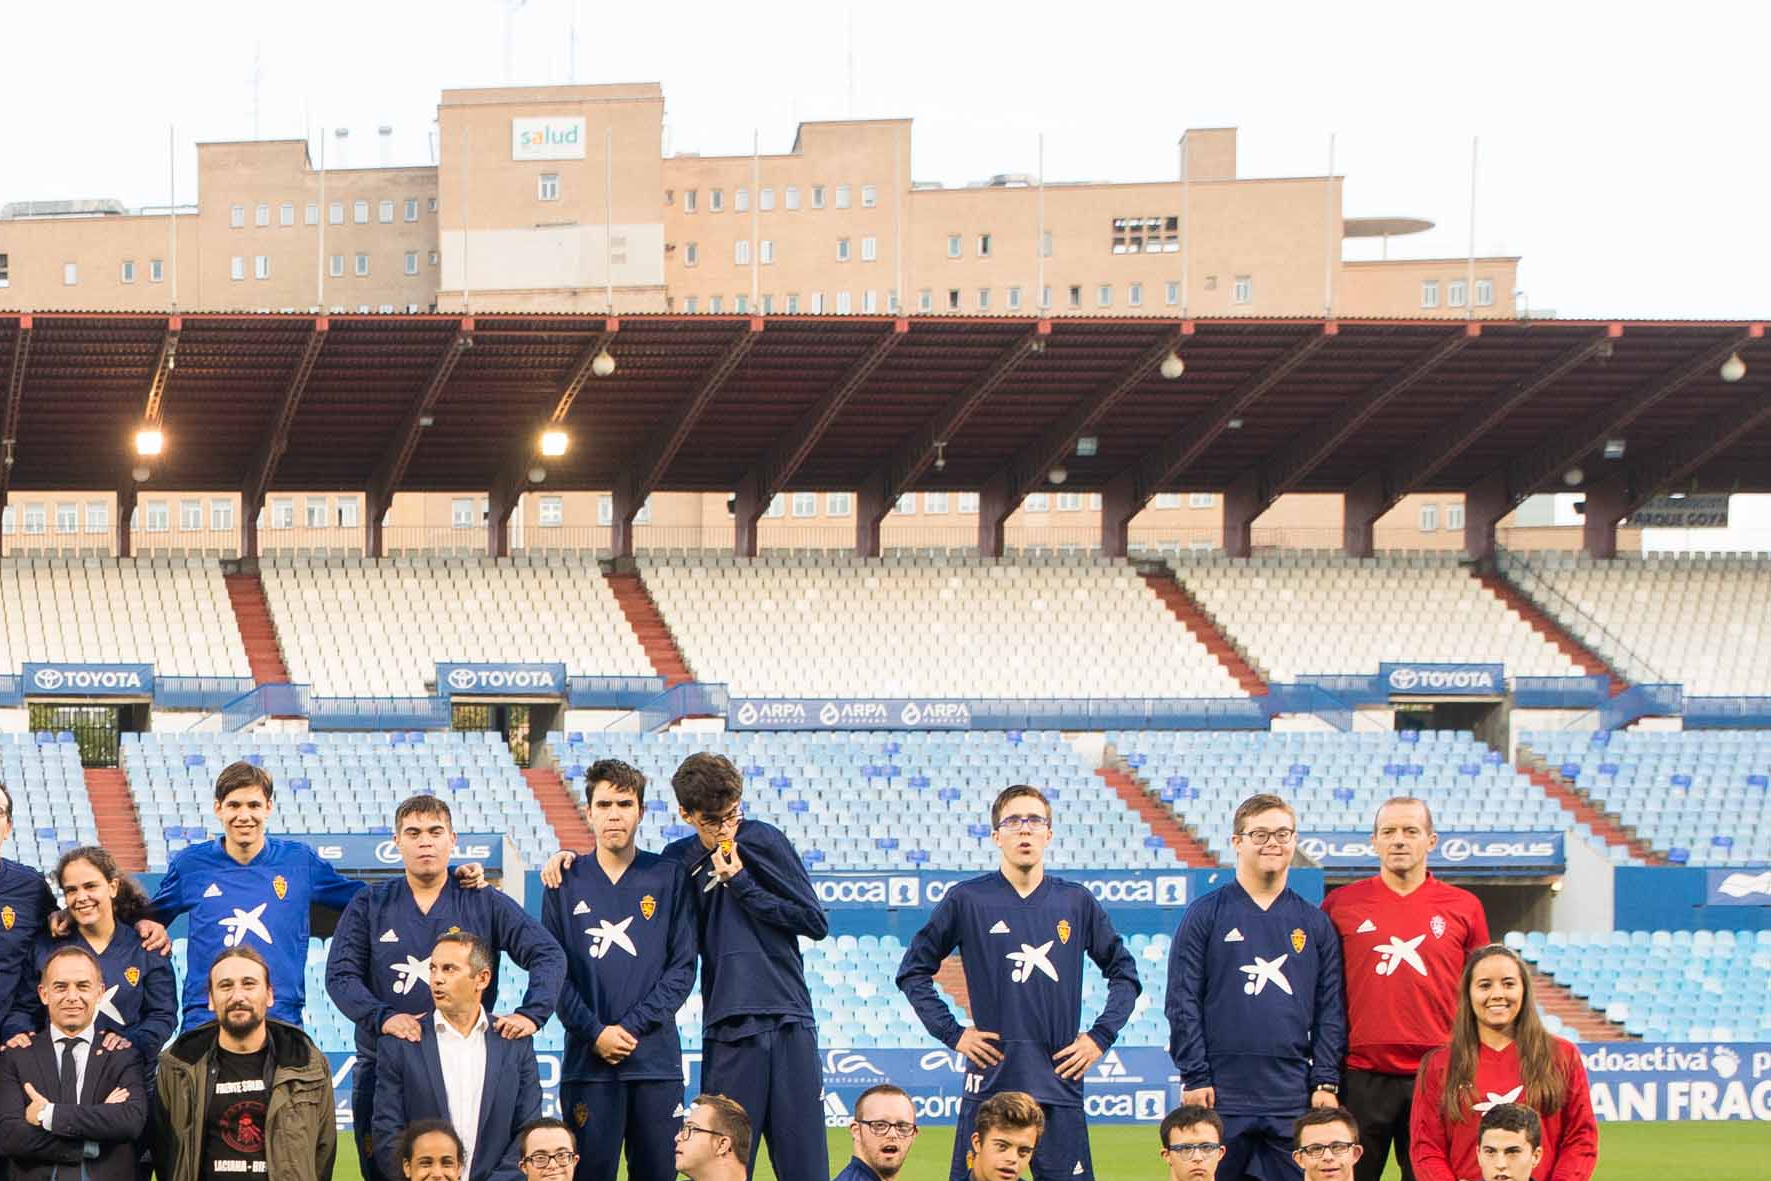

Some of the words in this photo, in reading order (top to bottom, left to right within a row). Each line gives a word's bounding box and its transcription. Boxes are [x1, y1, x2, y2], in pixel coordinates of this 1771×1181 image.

[520, 124, 579, 145] salud
[63, 671, 142, 689] TOYOTA
[476, 671, 554, 689] TOYOTA
[1418, 671, 1494, 687] TOYOTA
[758, 702, 806, 718] ARPA
[841, 702, 889, 718] ARPA
[922, 702, 970, 718] ARPA
[1472, 843, 1554, 858] LEXUS
[964, 1073, 985, 1094] AT
